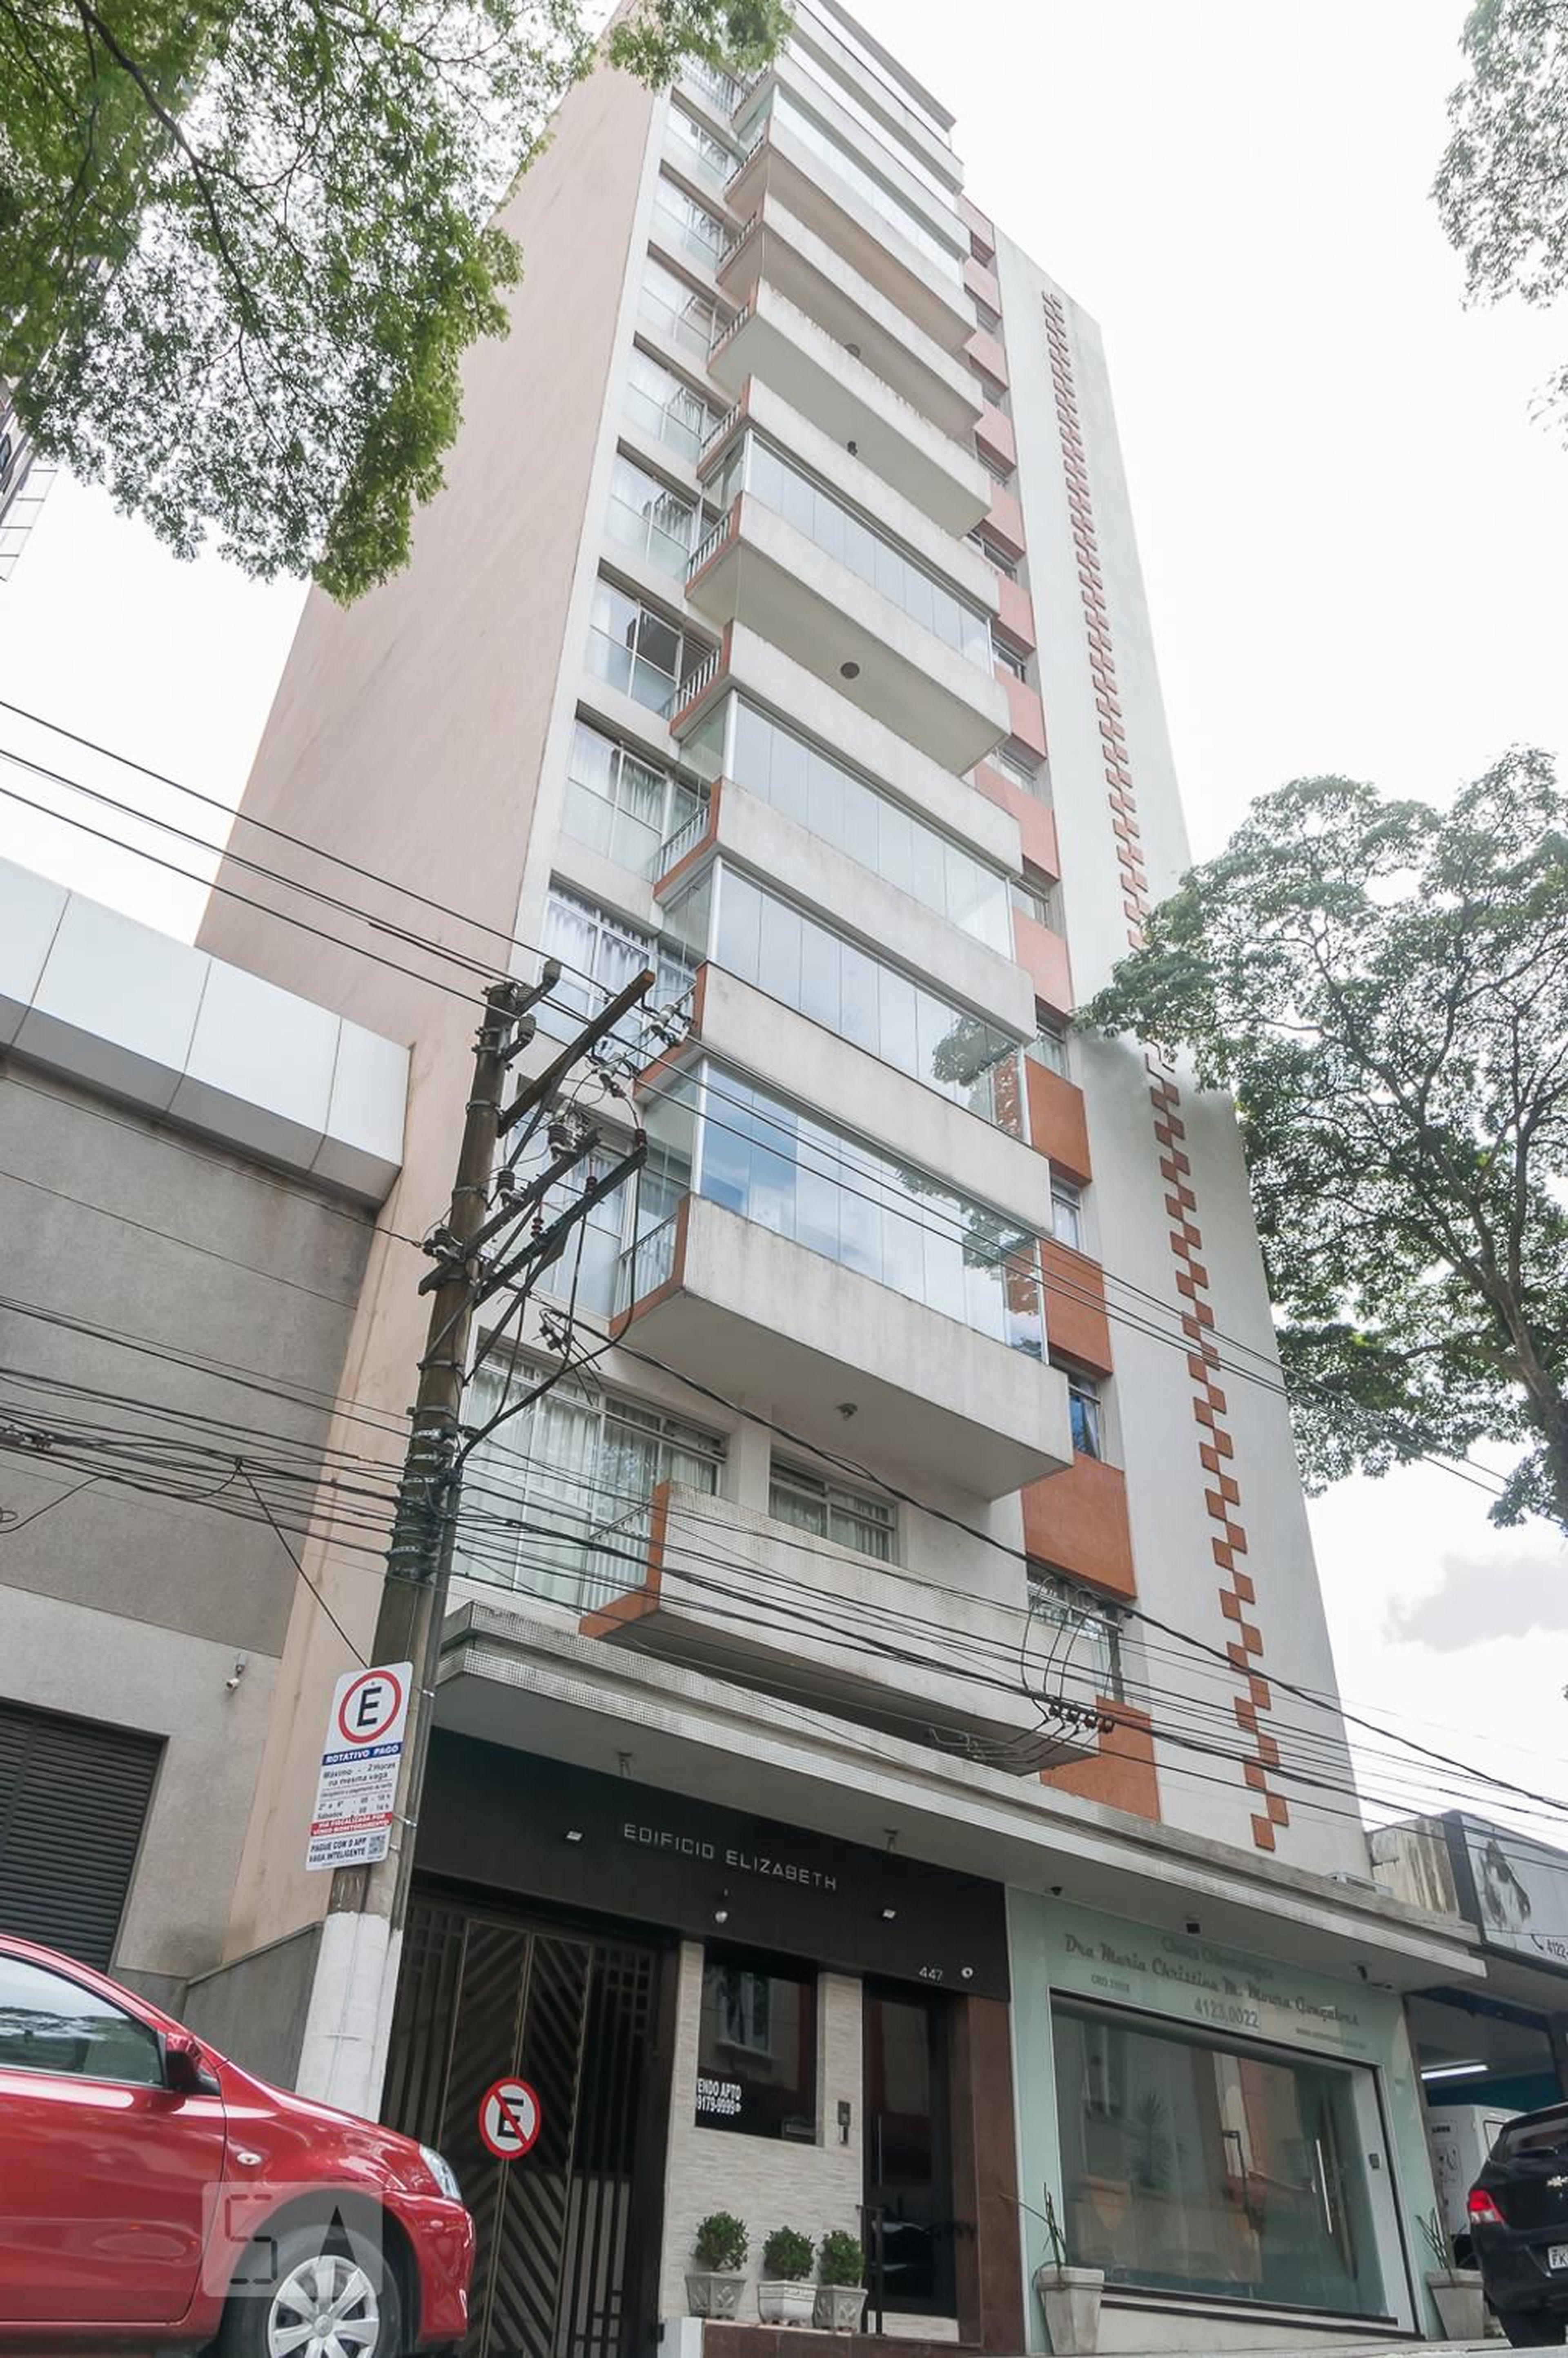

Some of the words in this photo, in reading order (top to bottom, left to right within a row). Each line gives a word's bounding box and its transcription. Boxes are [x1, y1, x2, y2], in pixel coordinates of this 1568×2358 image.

[357, 1686, 382, 1727] E
[325, 1750, 369, 1763] ROTATIVO
[373, 1745, 399, 1755] PAGO
[327, 1847, 365, 1859] INTELIGENTE
[624, 1823, 715, 1859] EDIFICIO
[726, 1849, 837, 1890] ELIZABETH
[1100, 1942, 1147, 1972] Maria
[919, 1966, 942, 1982] 447
[720, 2082, 742, 2101] APTO
